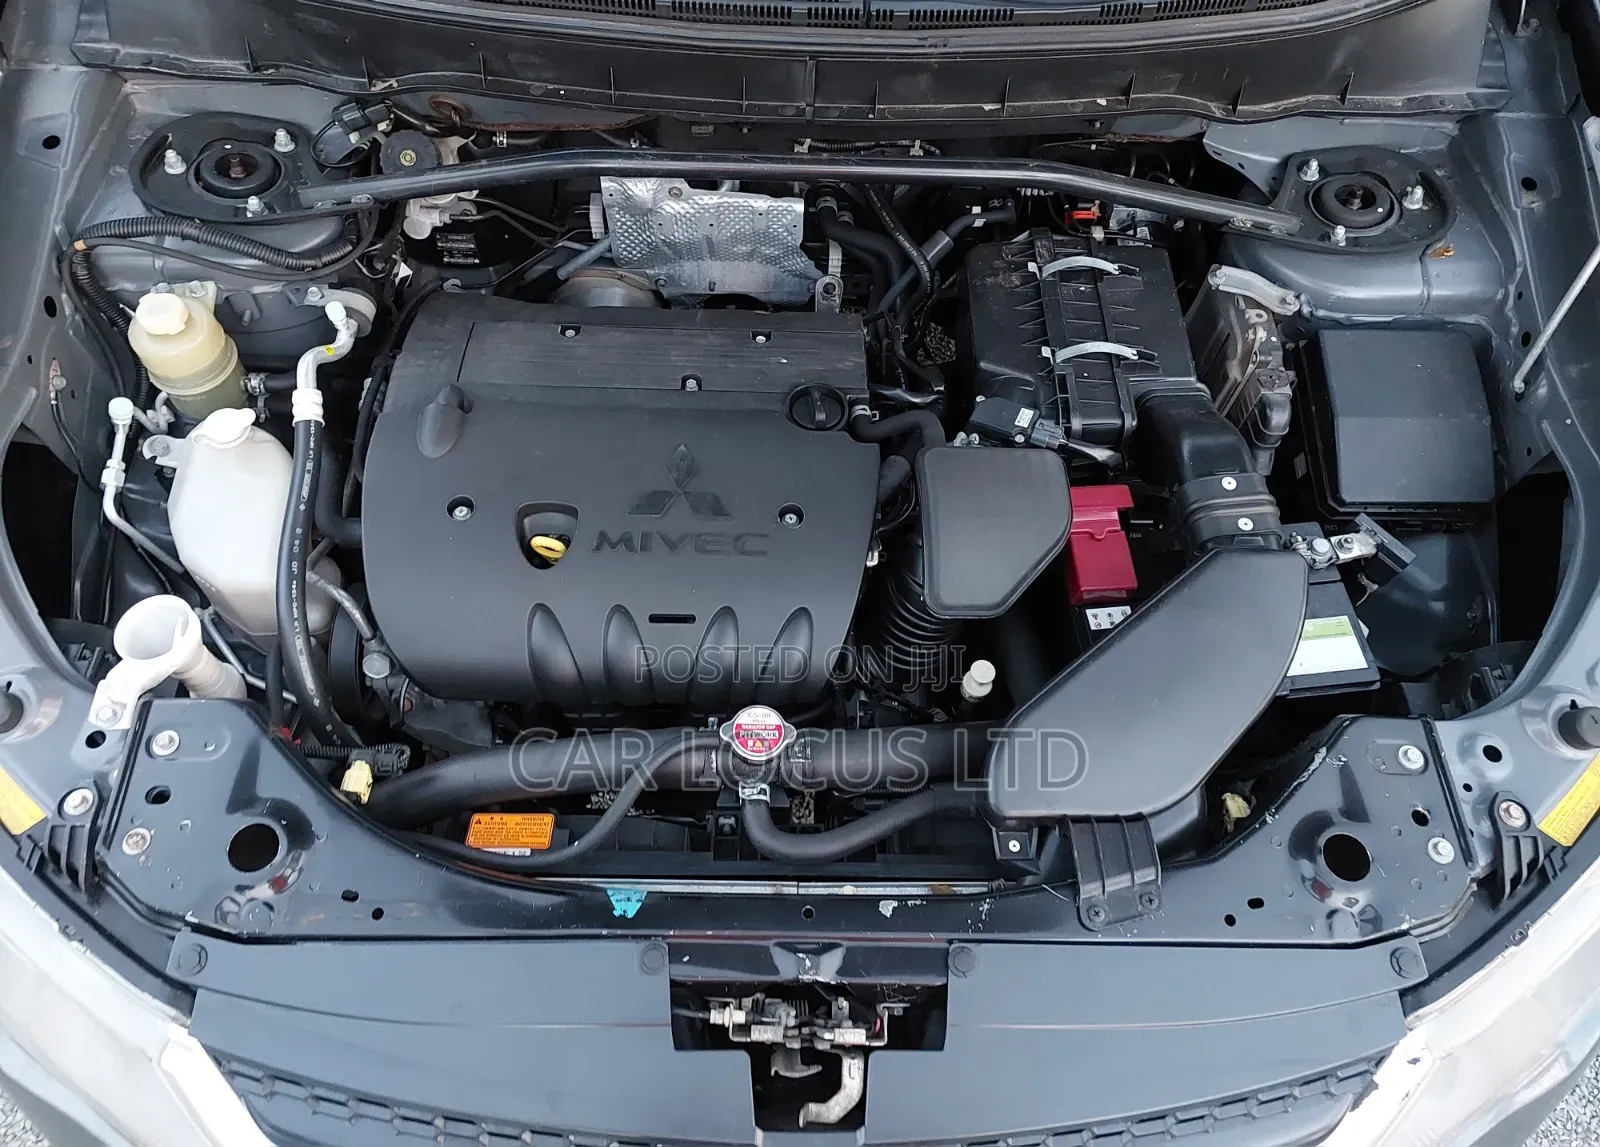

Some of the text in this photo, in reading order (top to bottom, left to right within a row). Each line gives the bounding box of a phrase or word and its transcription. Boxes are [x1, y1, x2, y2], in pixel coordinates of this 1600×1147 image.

[591, 530, 771, 557] MIVEC
[291, 561, 298, 575] JD
[740, 730, 778, 739] PITWORK
